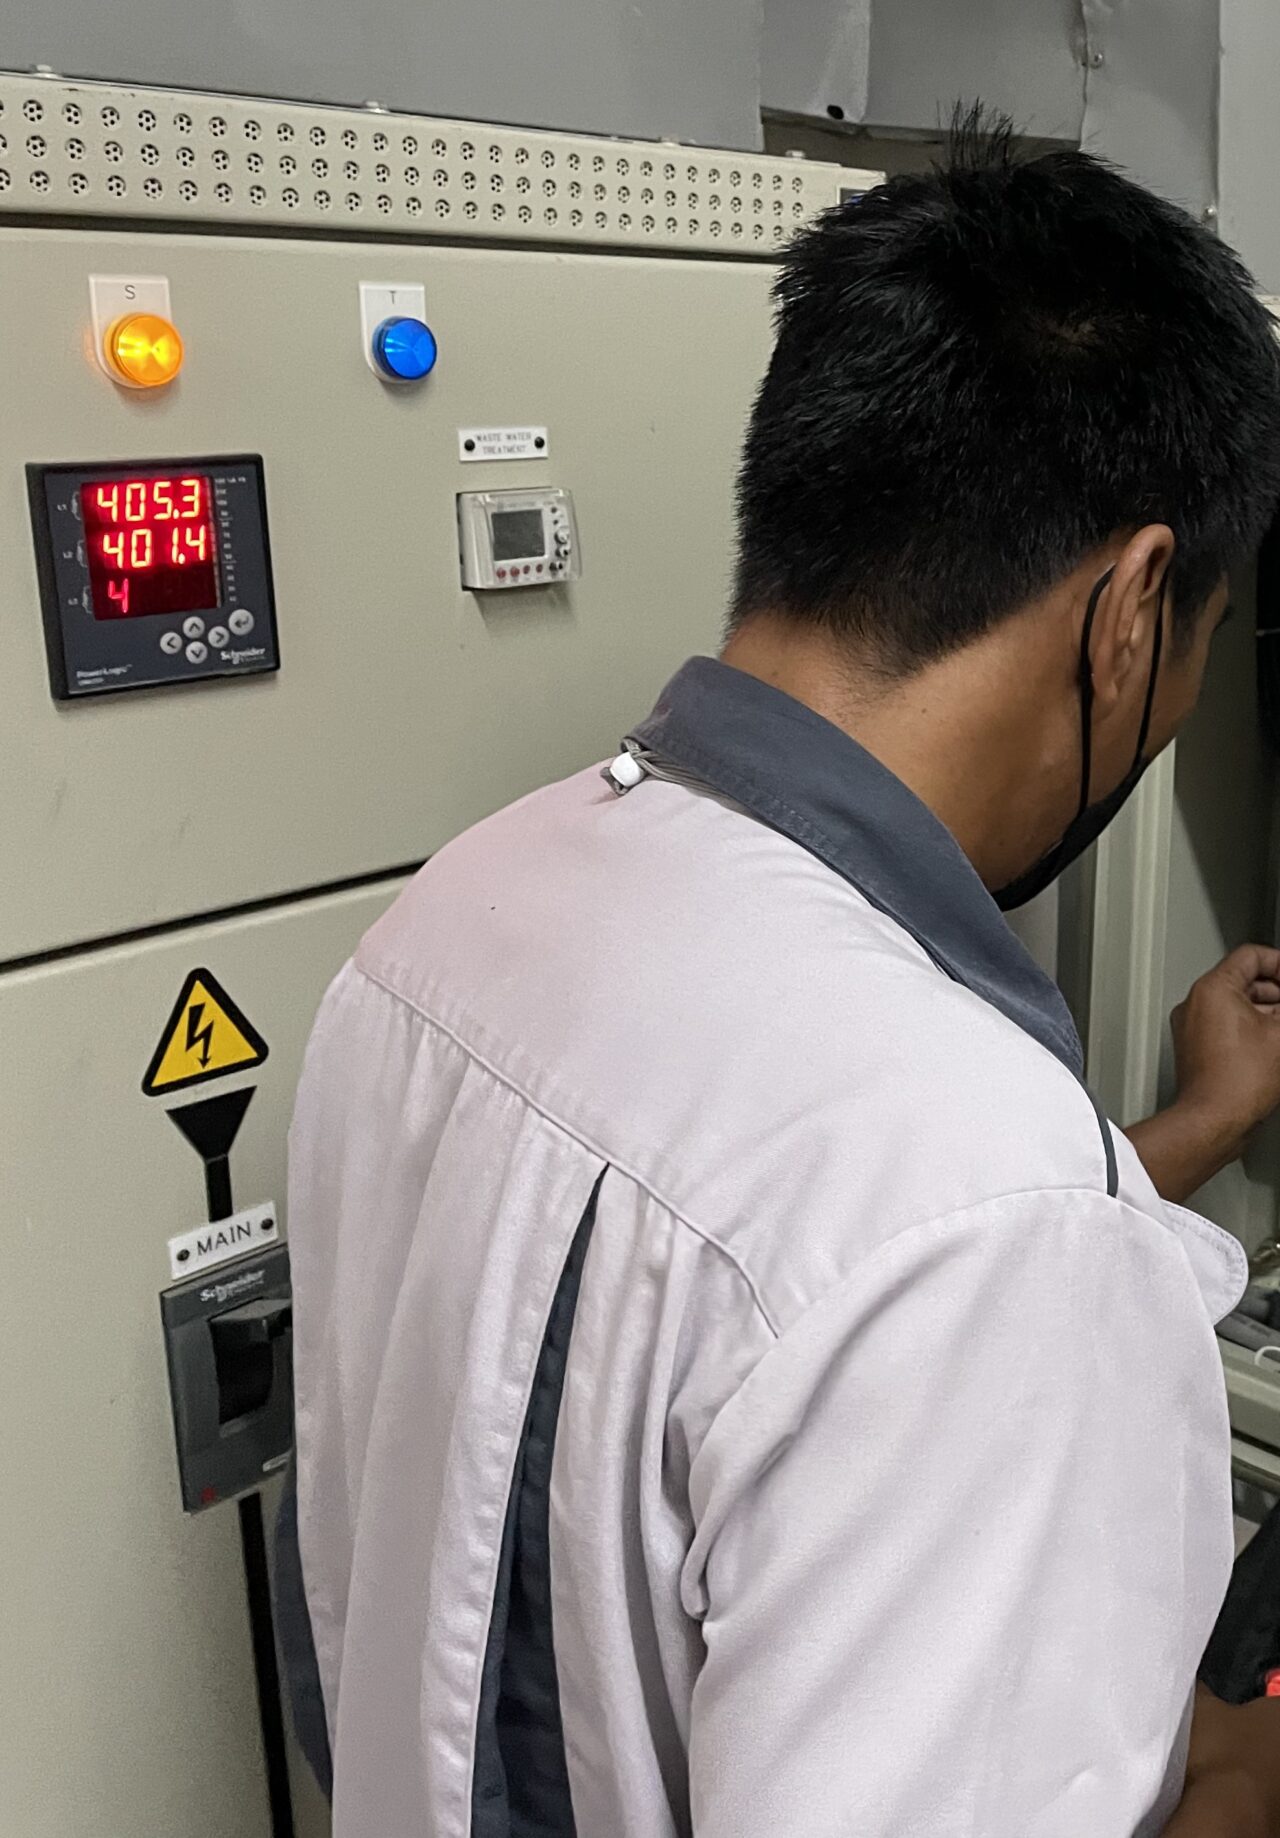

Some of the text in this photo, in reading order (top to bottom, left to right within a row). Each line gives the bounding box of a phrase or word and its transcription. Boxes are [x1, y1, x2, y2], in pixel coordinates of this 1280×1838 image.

[124, 284, 136, 301] S
[388, 290, 398, 305] T
[475, 431, 531, 442] WASTE WATER
[482, 444, 526, 455] TREATMENT
[97, 479, 200, 522] 405.3
[103, 525, 206, 569] 401.4
[108, 578, 129, 614] 4
[196, 1220, 251, 1256] MAIN
